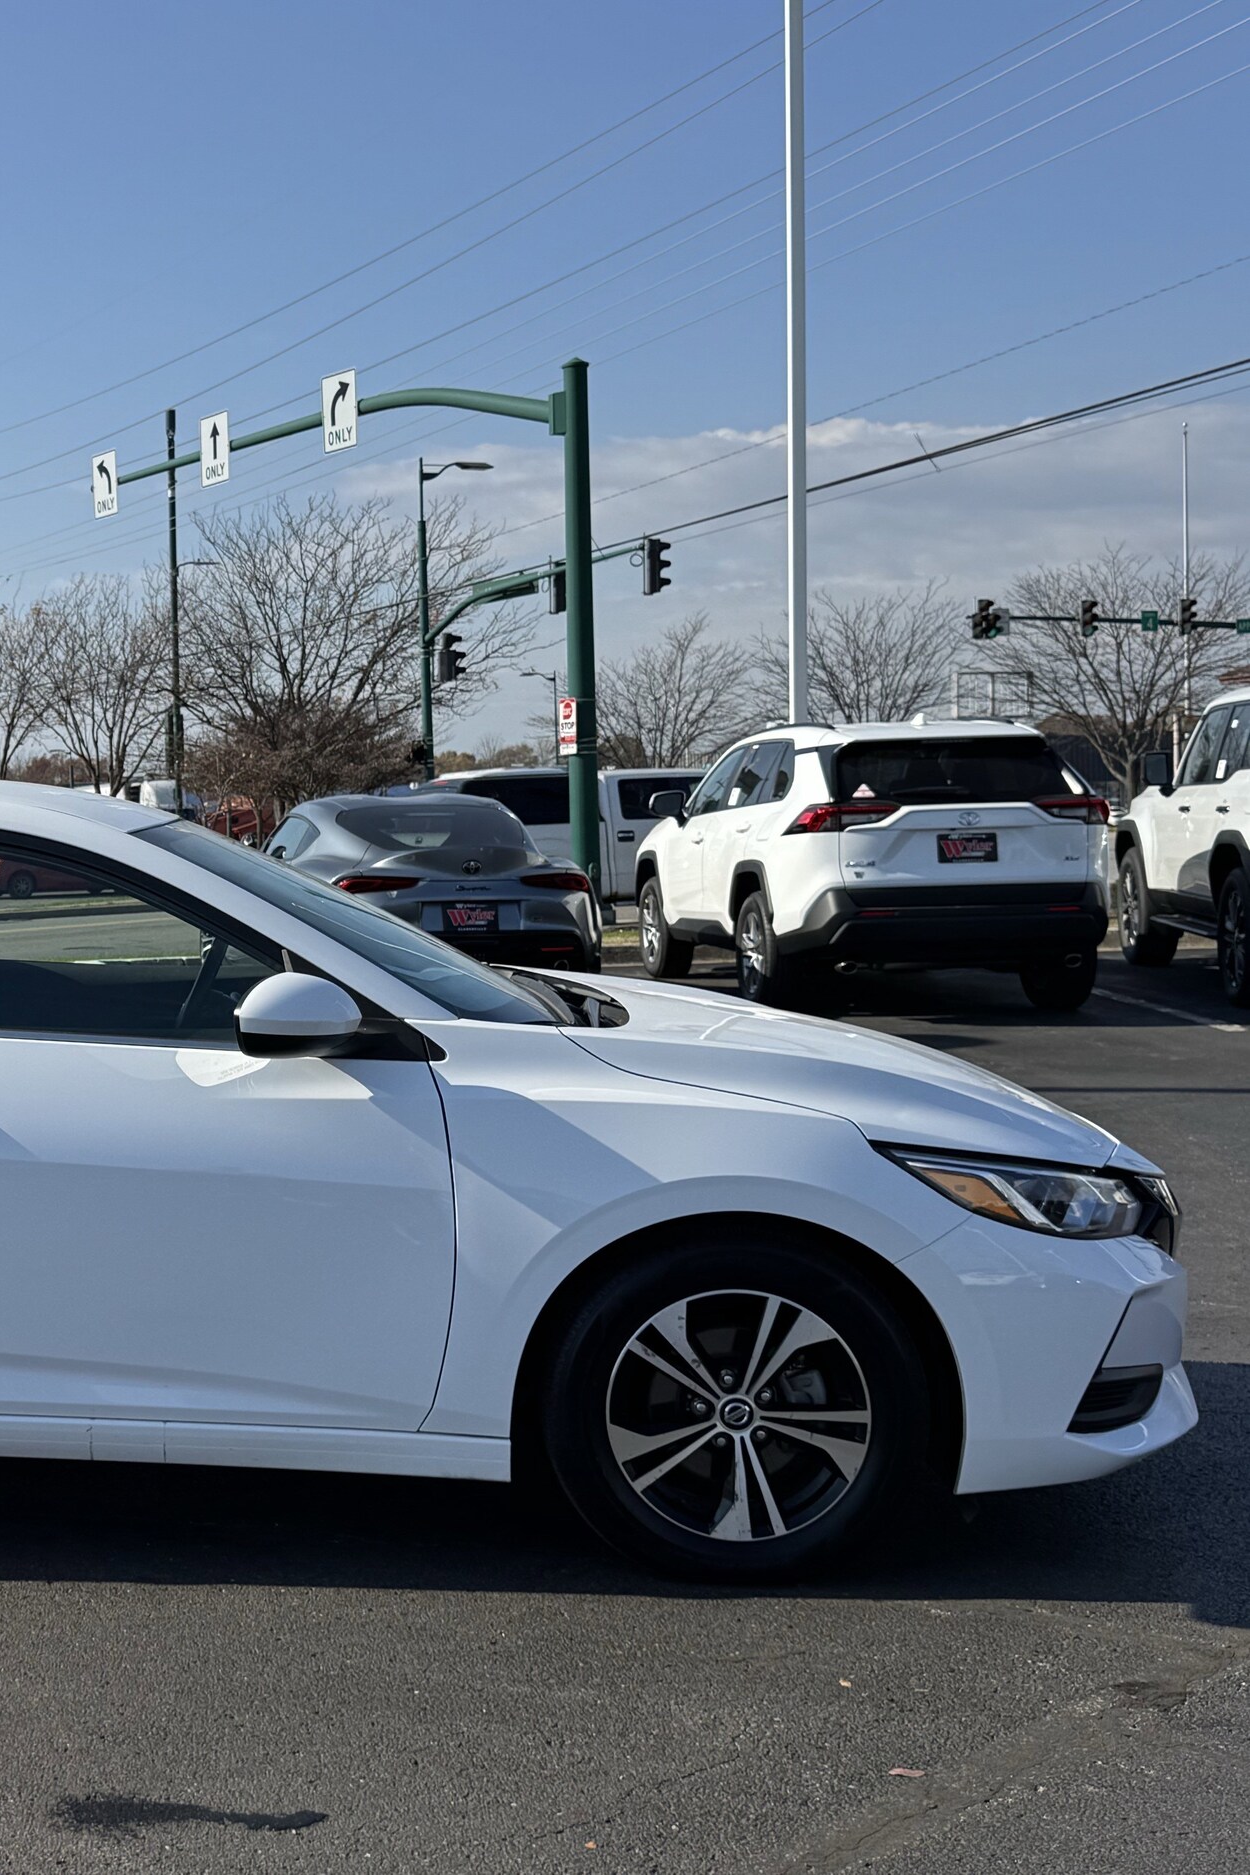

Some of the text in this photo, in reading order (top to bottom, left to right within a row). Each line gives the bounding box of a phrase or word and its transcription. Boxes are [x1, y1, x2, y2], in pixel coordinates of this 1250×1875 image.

[327, 425, 353, 447] ONLY
[205, 462, 226, 481] ONLY
[97, 496, 116, 515] ONLY
[561, 721, 575, 730] STOP
